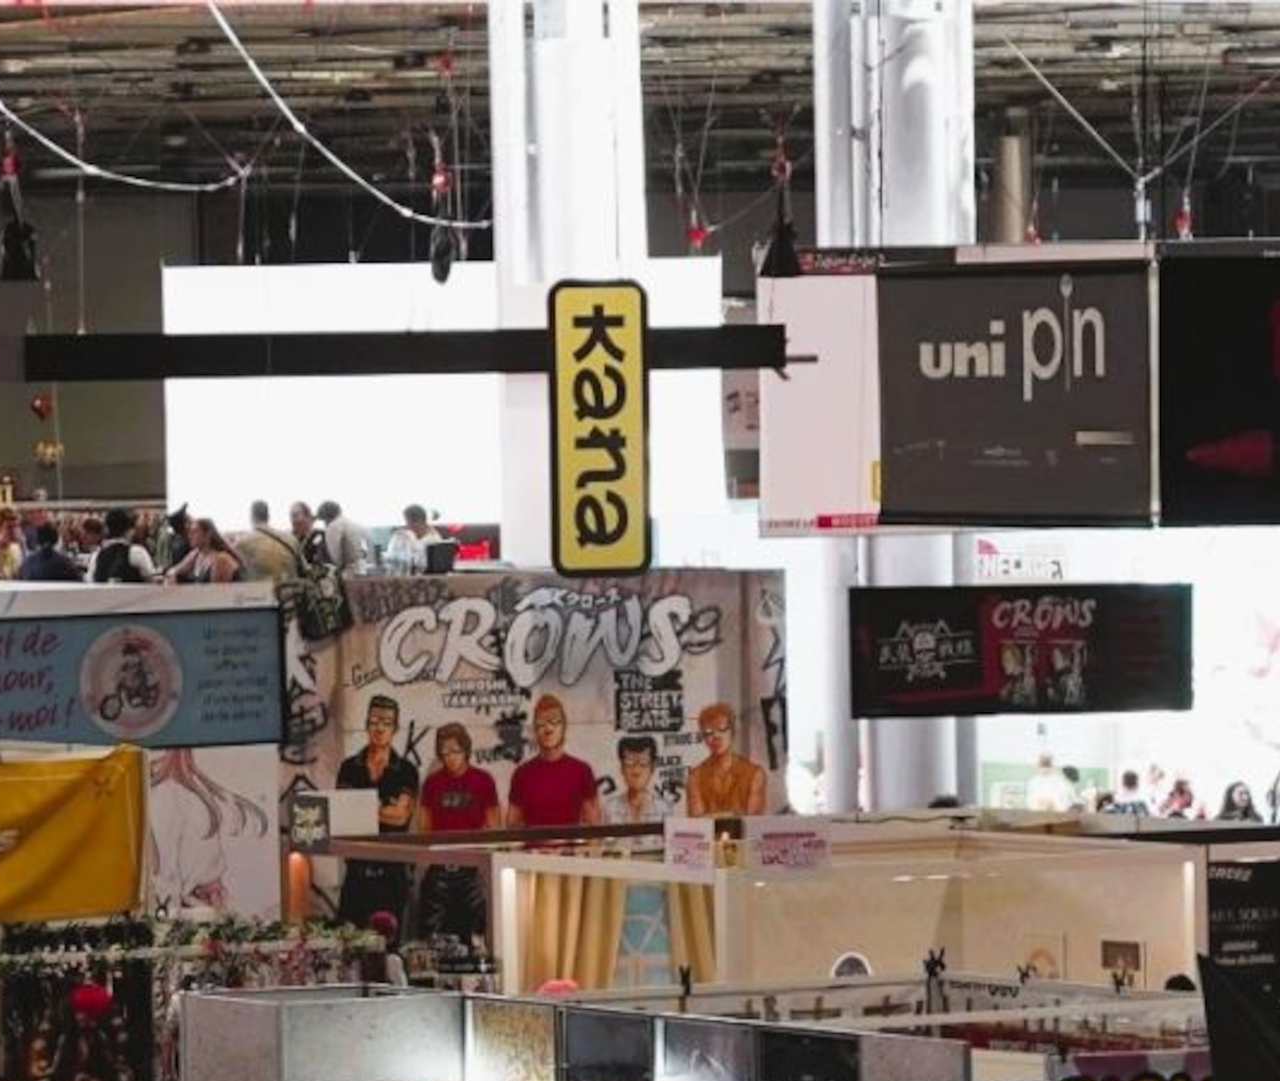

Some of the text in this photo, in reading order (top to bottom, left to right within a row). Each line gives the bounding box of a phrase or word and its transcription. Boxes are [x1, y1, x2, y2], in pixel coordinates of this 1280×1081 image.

[919, 274, 1108, 402] uni pin
[572, 303, 628, 549] kana
[22, 622, 62, 656] de
[377, 592, 692, 690] CROWS
[991, 596, 1097, 630] CROWS
[618, 673, 654, 692] THE
